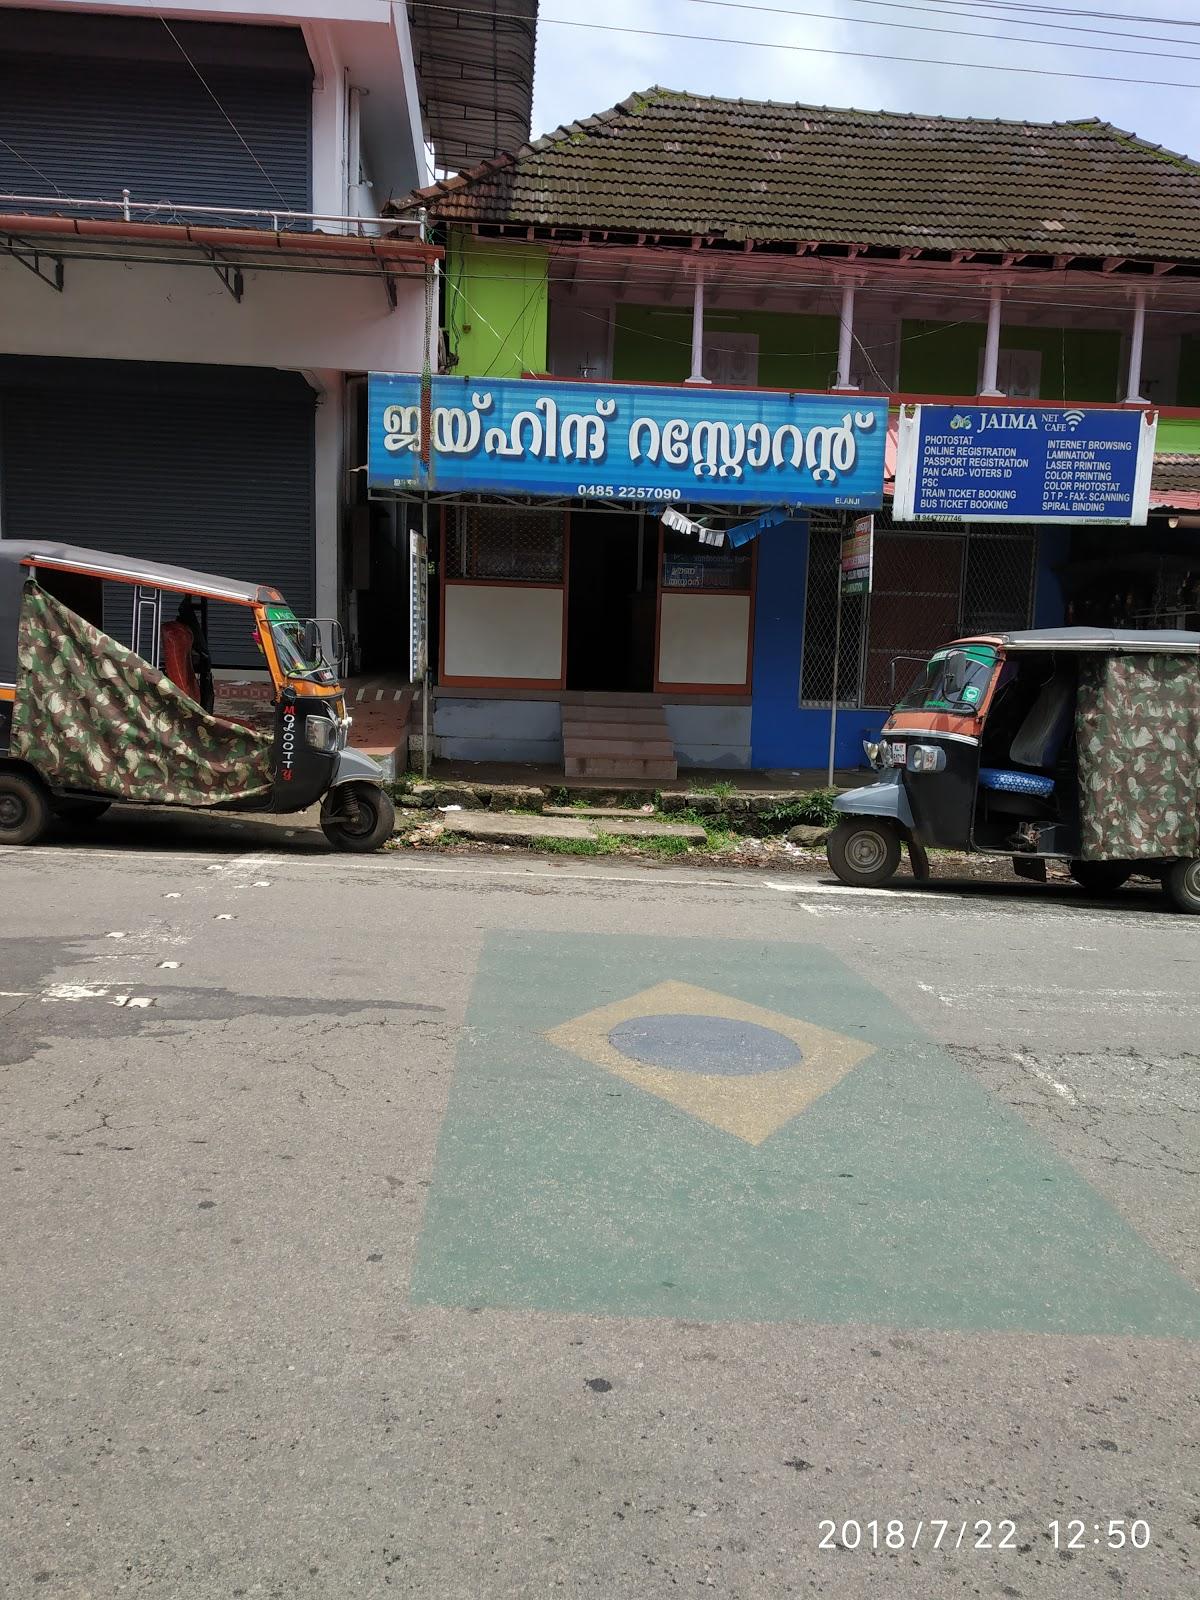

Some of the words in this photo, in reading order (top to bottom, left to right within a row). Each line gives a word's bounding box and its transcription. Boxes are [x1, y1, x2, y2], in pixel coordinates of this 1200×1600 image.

[977, 413, 1038, 433] JAIMA
[1042, 414, 1059, 422] NET
[925, 436, 973, 446] PHOTOSTAT
[1048, 441, 1087, 450] INTERNET
[1089, 442, 1131, 451] BROWSING
[925, 447, 955, 455] ONLINE
[957, 447, 1016, 456] REGISTRATION
[1047, 451, 1095, 459] LAMINATION
[924, 457, 967, 466] PASSPORT
[969, 458, 1028, 467] REGISTRATION
[1046, 461, 1072, 470] LASER
[1074, 462, 1111, 471] PRINTING
[923, 468, 939, 476] PAN
[969, 468, 1002, 477] VOTERS
[1004, 469, 1012, 478] ID
[1045, 471, 1073, 480] COLOR
[1075, 472, 1111, 481] PRINTING
[922, 478, 938, 486] PSC
[1044, 482, 1072, 490] COLOR
[1075, 482, 1120, 491] PHOTOSTAT
[578, 485, 617, 498] 0485
[618, 487, 680, 499] 2257090
[922, 489, 946, 498] TRAIN
[948, 489, 977, 498] TICKET
[979, 490, 1016, 499] BOOKING
[1089, 493, 1129, 502] SCANNING
[921, 500, 937, 508] BUS
[940, 500, 968, 508] TICKET
[971, 500, 1008, 509] BOOKING
[1042, 502, 1070, 510] SPIRAL
[1072, 503, 1104, 511] BINDING
